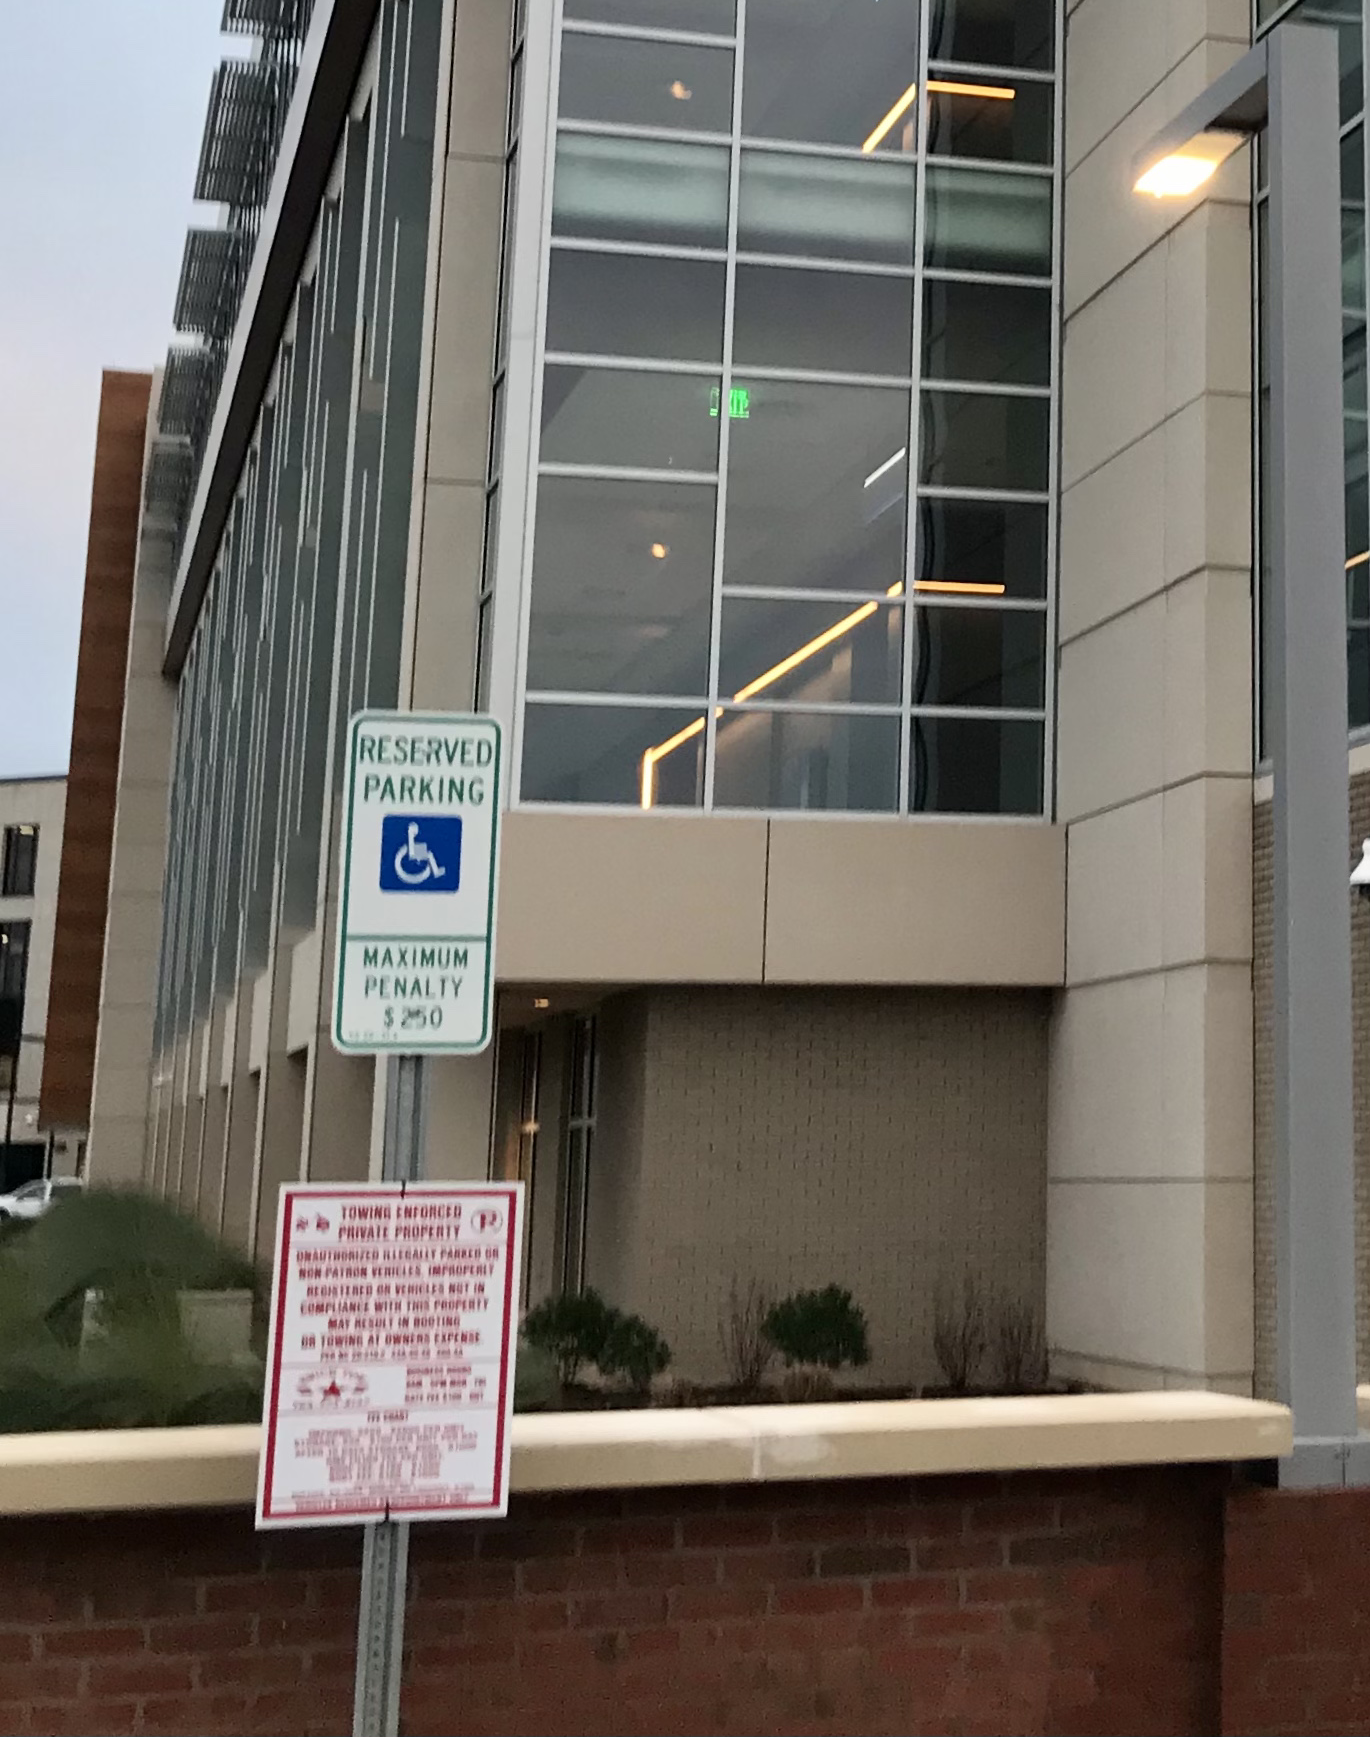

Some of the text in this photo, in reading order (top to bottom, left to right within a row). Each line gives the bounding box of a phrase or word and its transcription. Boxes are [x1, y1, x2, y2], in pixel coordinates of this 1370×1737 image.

[359, 734, 493, 767] RESERVED
[363, 774, 485, 805] PARKING
[362, 946, 470, 970] MAXIMUM
[364, 976, 464, 999] PENALTY
[342, 1203, 462, 1221] TOWING ENFORCED
[338, 1224, 460, 1241] PRIVATE PROPERTY
